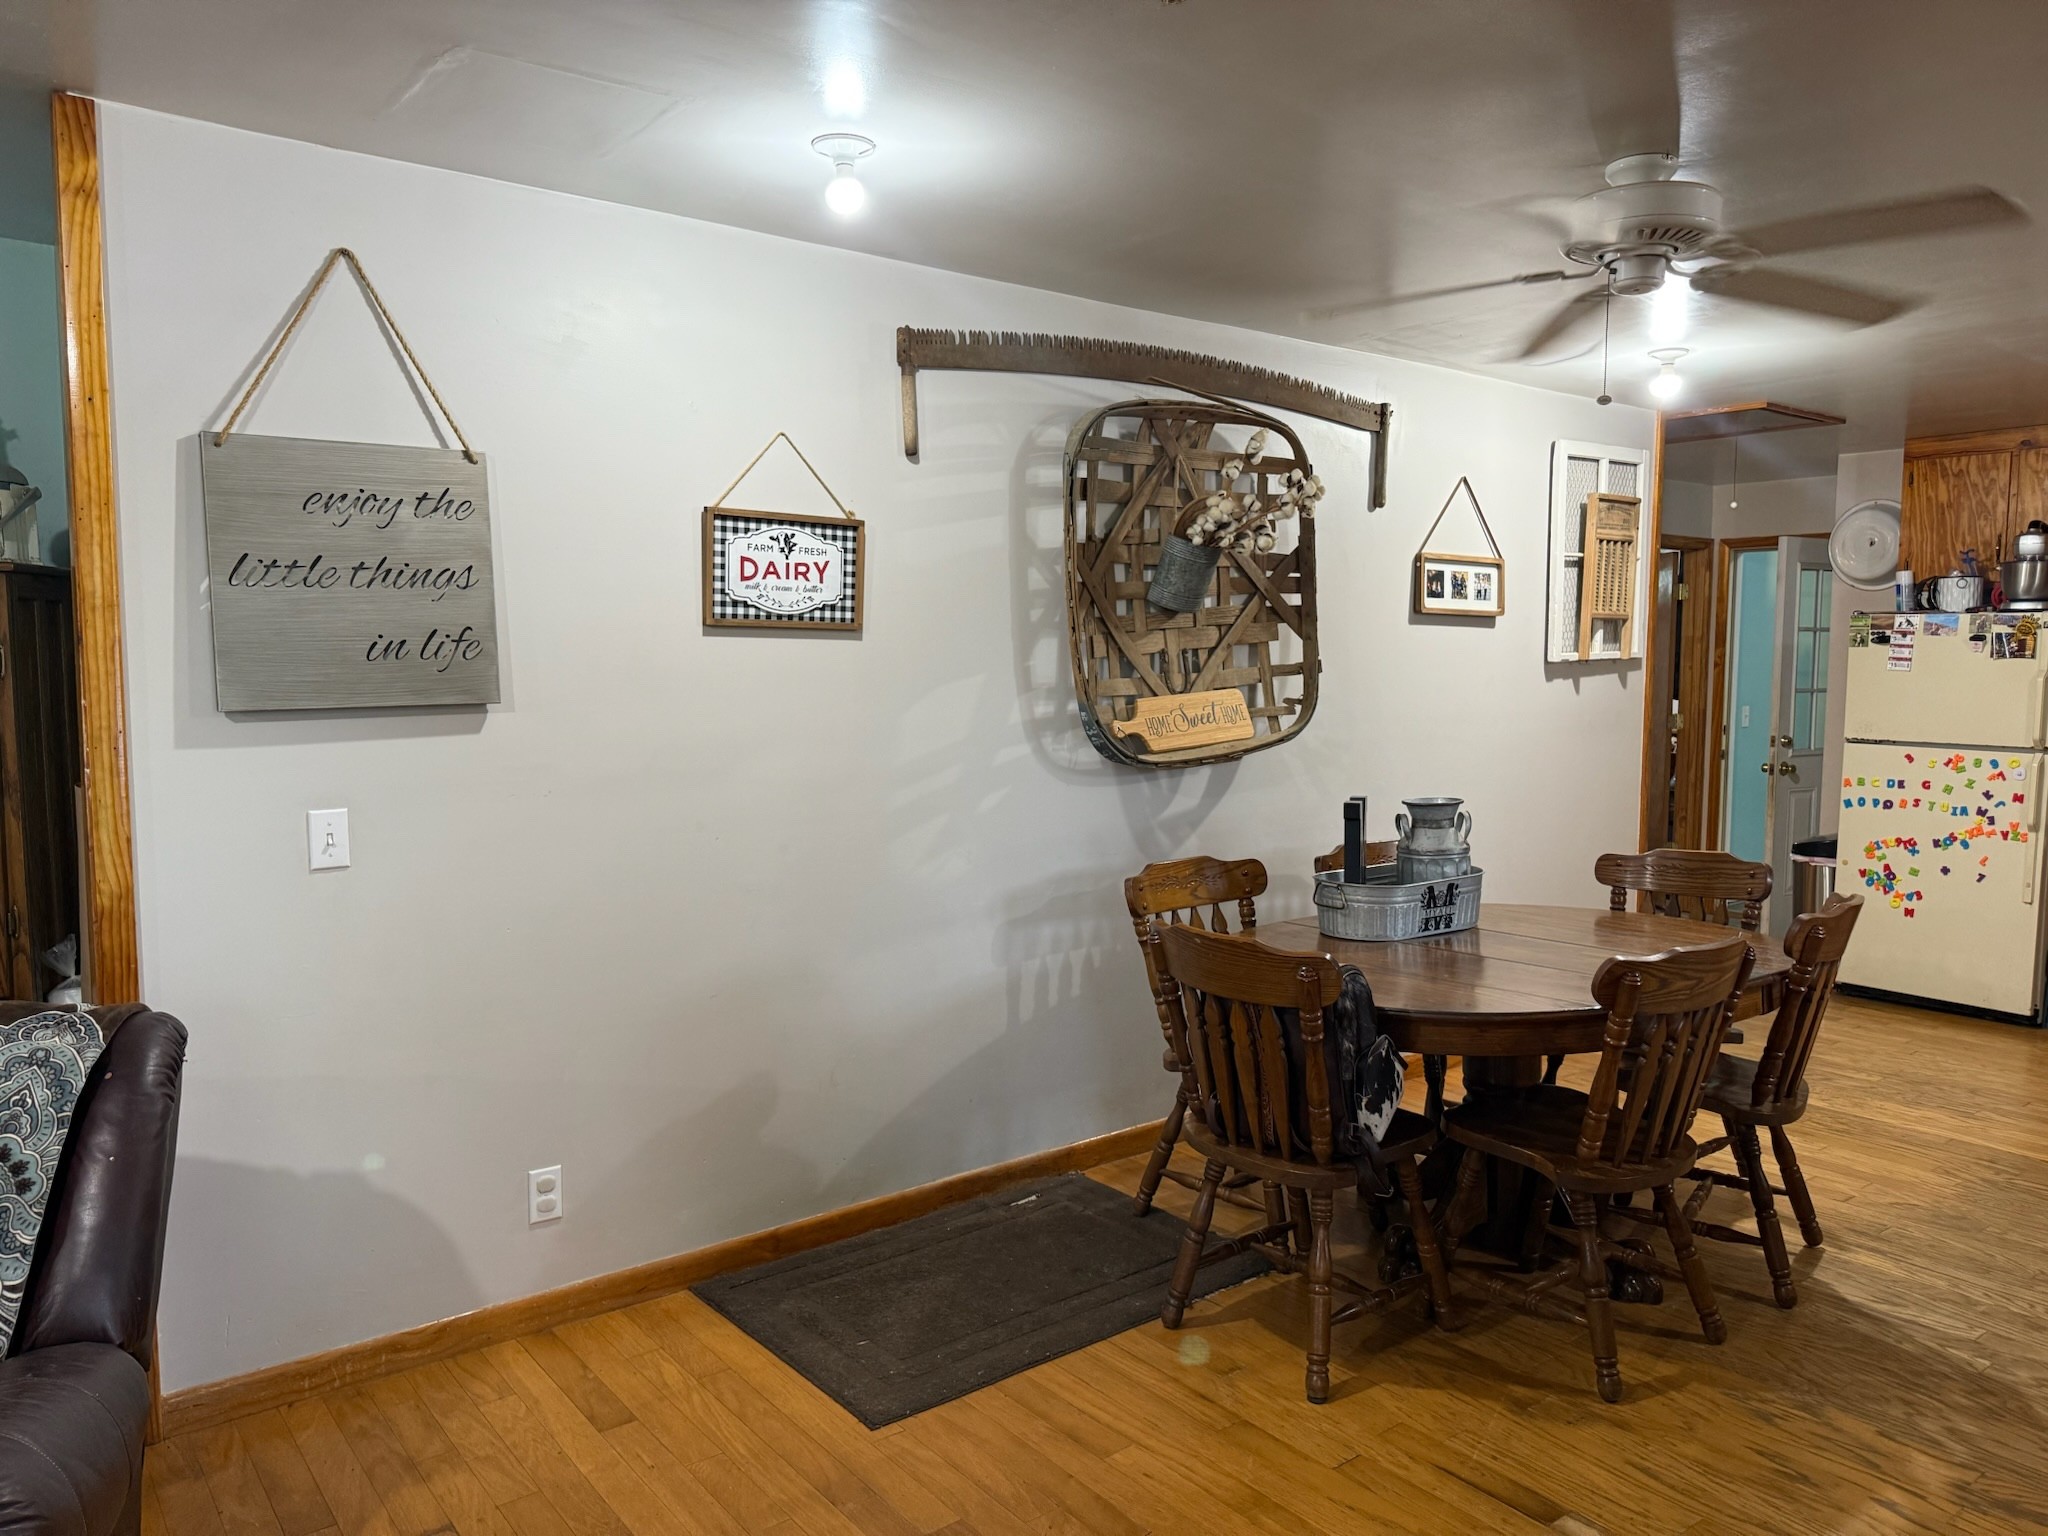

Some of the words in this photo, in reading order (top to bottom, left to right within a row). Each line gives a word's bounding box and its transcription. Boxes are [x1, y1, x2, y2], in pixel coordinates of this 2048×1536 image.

[302, 488, 403, 529] enjoy
[413, 487, 475, 521] the
[747, 543, 774, 552] FARM
[798, 547, 827, 556] FRESH
[228, 553, 341, 589] little
[350, 556, 480, 602] things
[740, 555, 830, 584] DAIRY
[366, 634, 411, 662] in
[419, 626, 483, 673] life
[1145, 714, 1174, 737] HOME
[1170, 701, 1223, 732] Sweet
[1220, 703, 1247, 725] HOME
[1843, 778, 1852, 788] A
[1871, 778, 1880, 787] C
[1887, 779, 1895, 788] D
[1897, 779, 1905, 789] E
[1922, 780, 1931, 790] G
[1872, 798, 1880, 808] P
